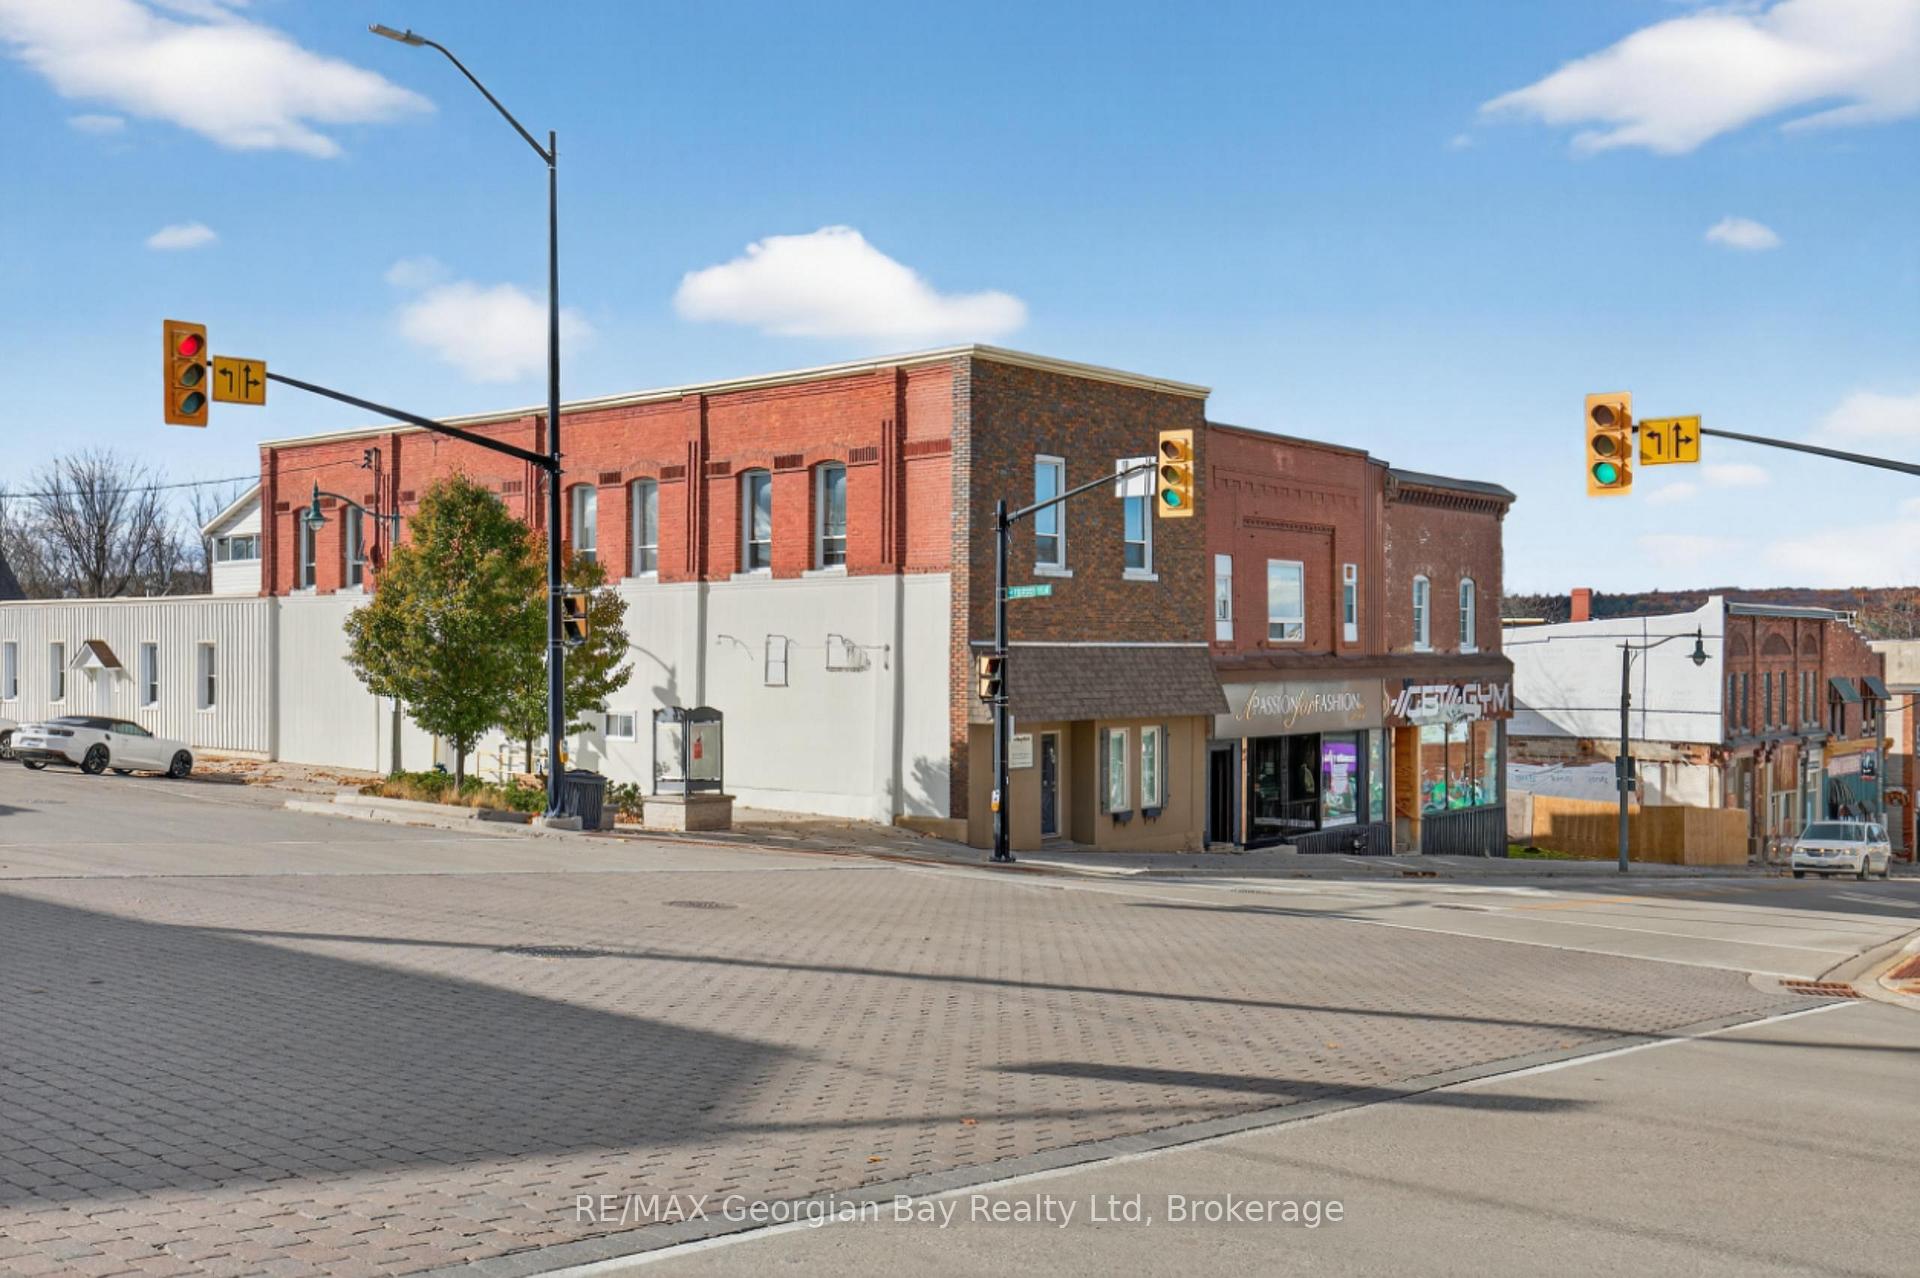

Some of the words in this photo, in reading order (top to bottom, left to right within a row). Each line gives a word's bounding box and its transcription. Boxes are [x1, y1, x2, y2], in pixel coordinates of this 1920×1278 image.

[1251, 693, 1296, 715] PASSION
[1314, 692, 1361, 713] FASHION
[1462, 683, 1510, 719] GYM
